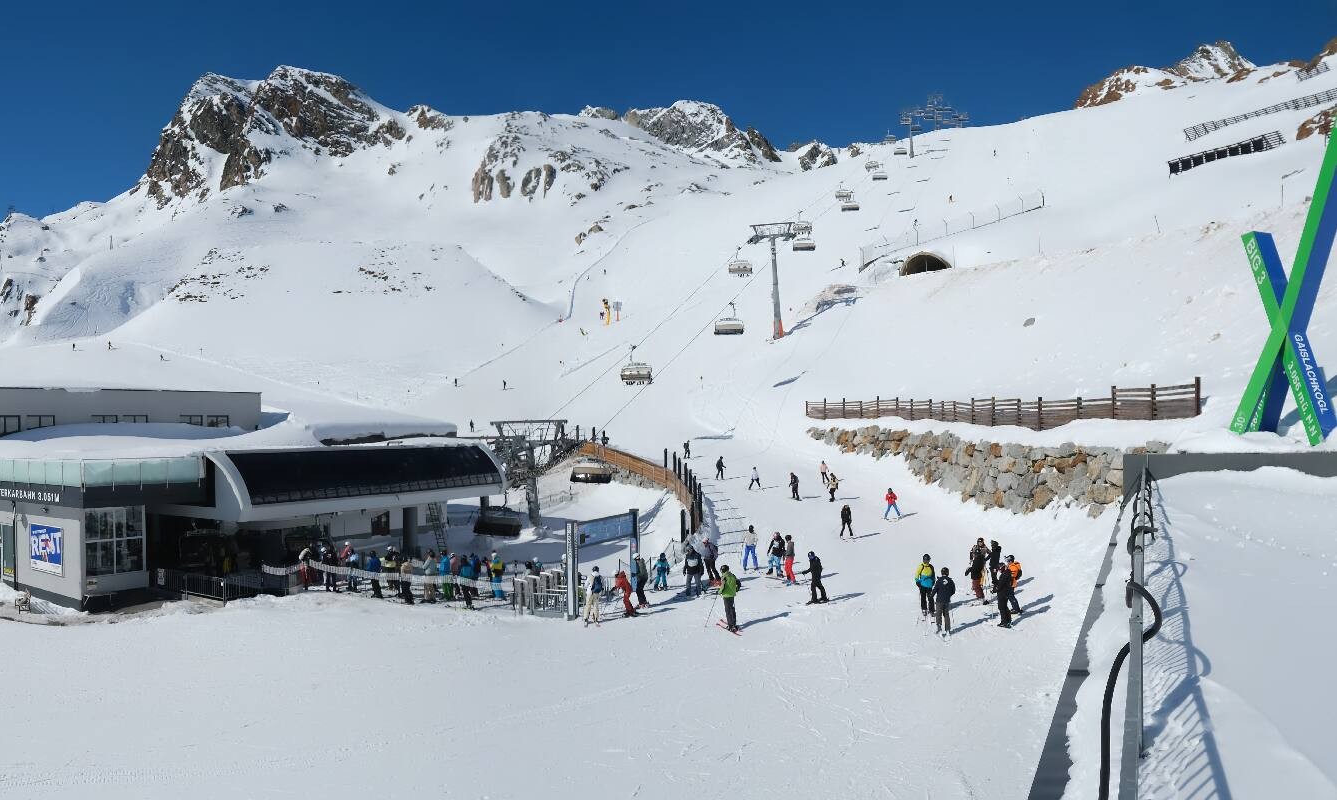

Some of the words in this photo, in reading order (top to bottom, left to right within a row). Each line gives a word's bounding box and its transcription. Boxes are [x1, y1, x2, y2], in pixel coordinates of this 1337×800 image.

[1246, 238, 1262, 271] BIG
[1257, 270, 1266, 285] 3
[1294, 334, 1329, 415] GAISLACHKOGL
[31, 531, 62, 556] RENT
